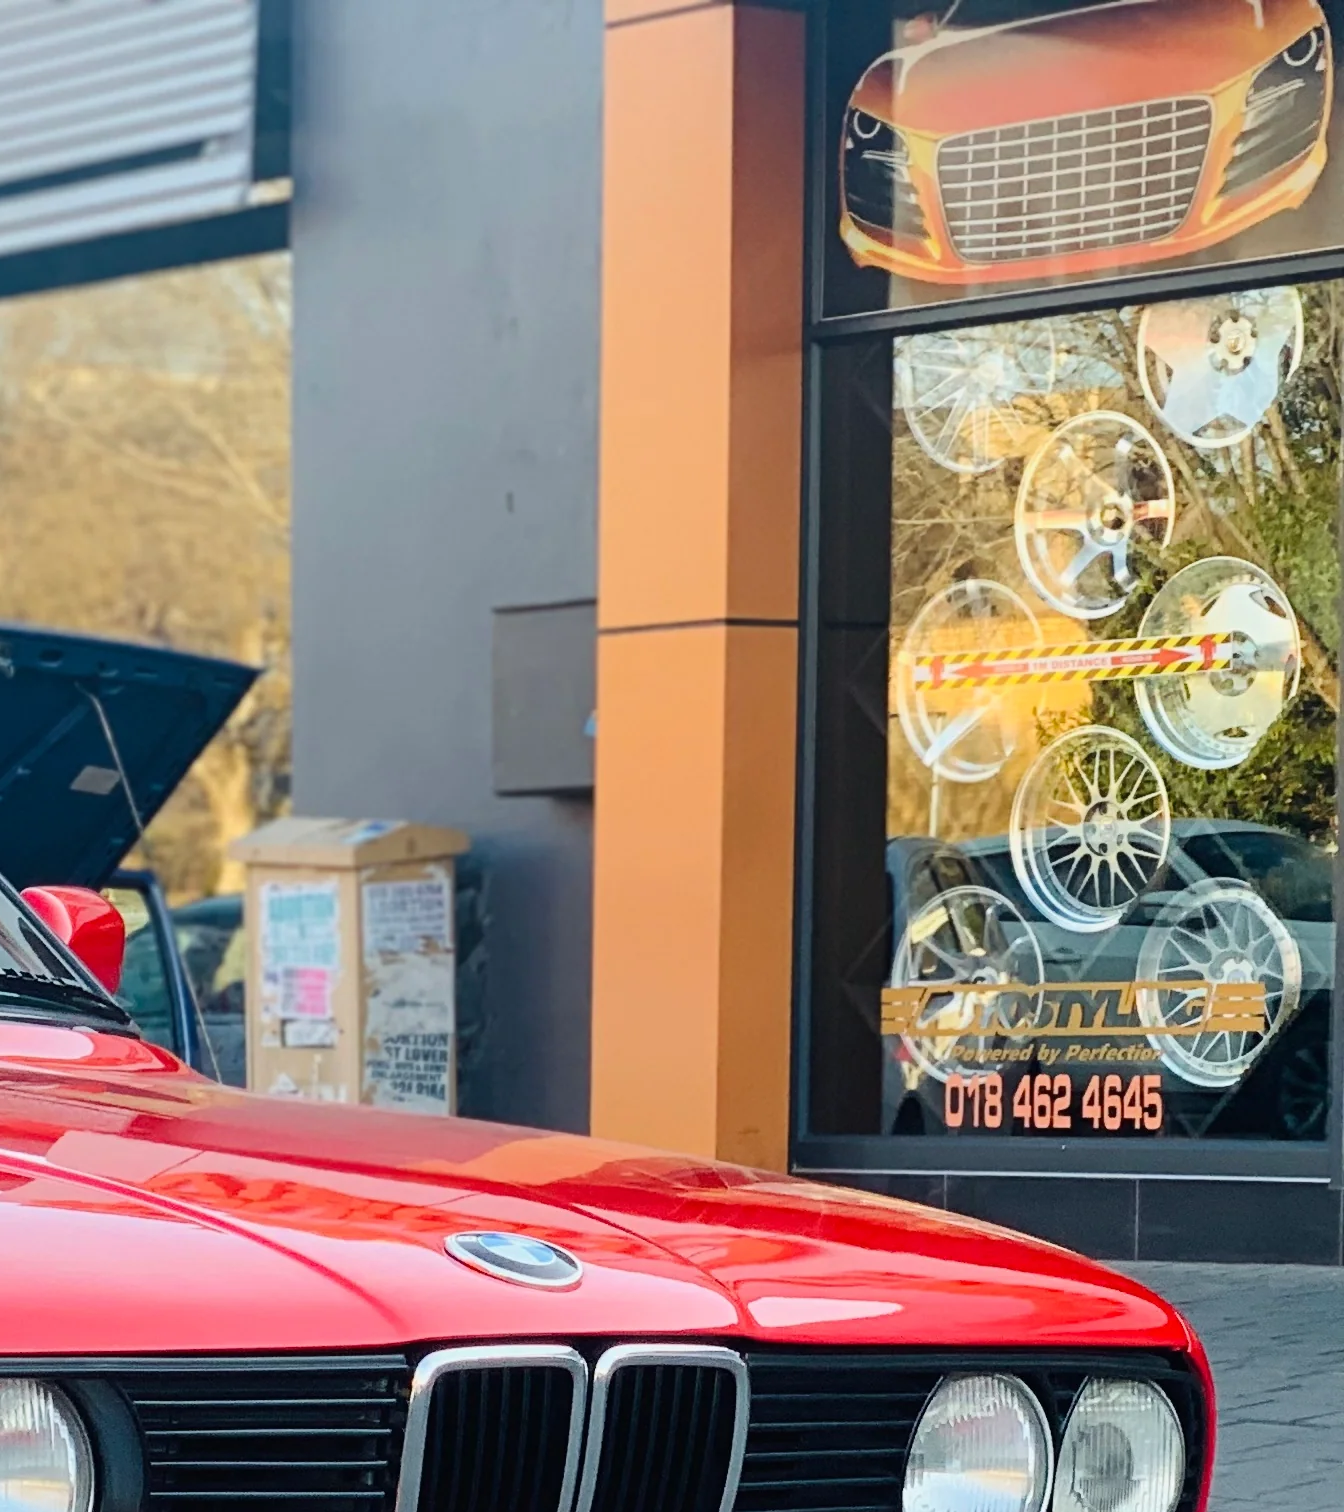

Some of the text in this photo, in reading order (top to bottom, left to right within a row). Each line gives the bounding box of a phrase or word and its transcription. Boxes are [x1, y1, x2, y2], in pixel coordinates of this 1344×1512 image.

[1051, 657, 1108, 670] DISTANCE
[953, 1042, 1162, 1066] Powered by Perfection
[945, 1072, 1162, 1130] 018 462 4645
